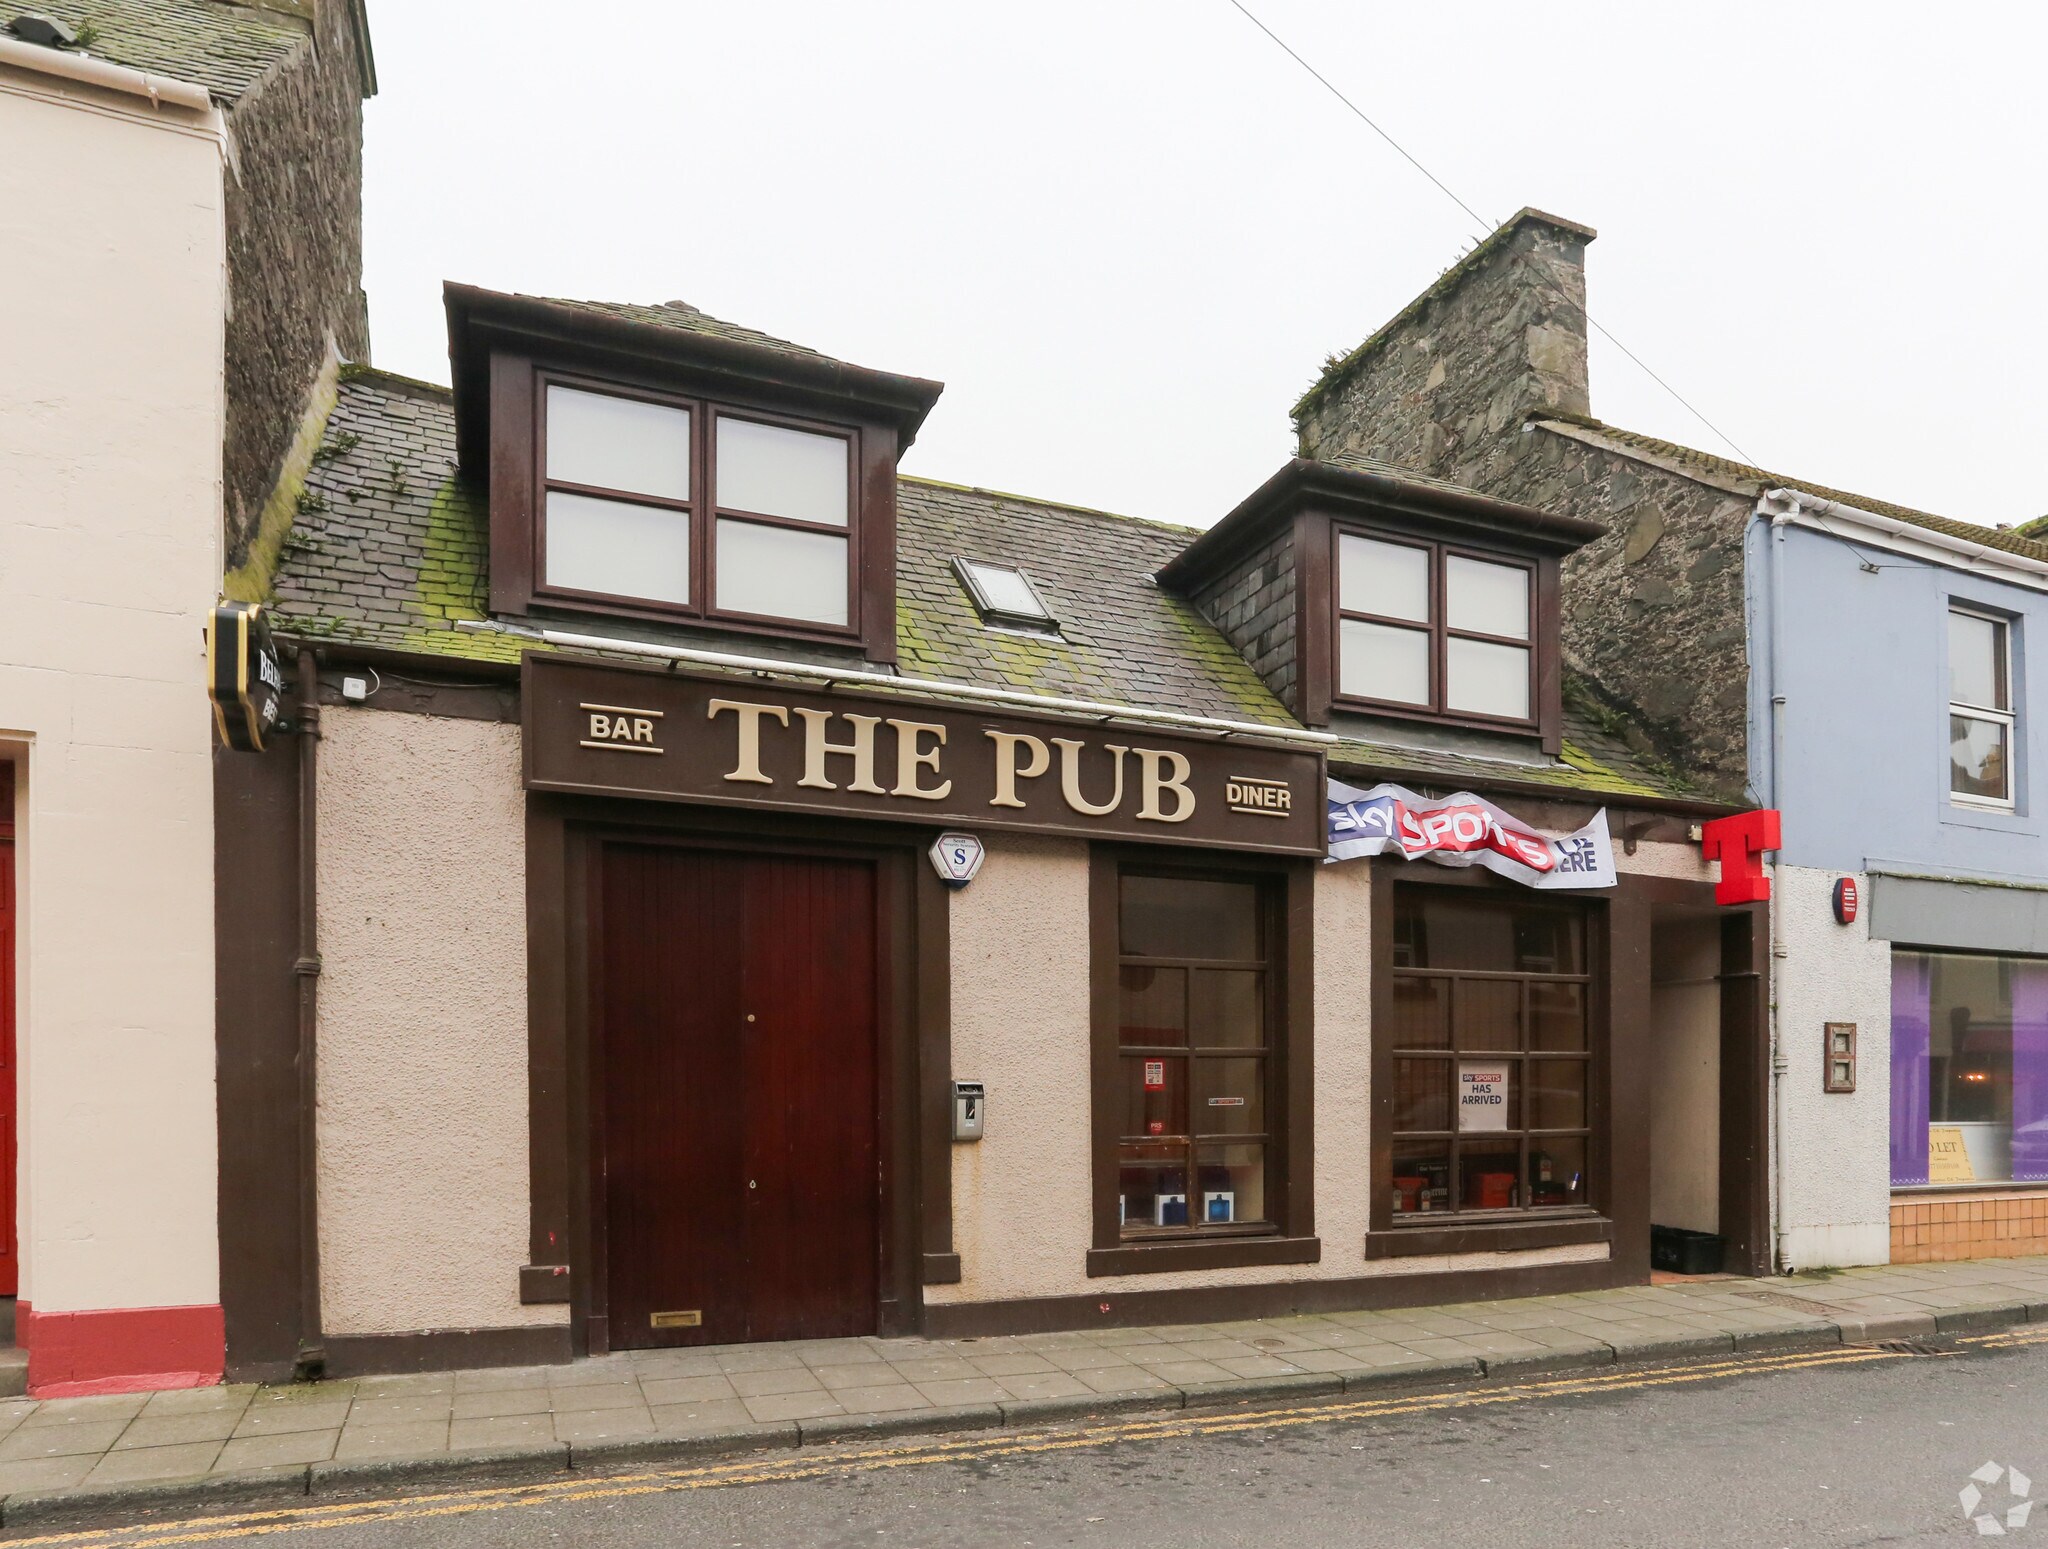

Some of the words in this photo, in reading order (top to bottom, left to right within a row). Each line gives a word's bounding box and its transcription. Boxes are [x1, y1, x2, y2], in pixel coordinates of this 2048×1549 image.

[590, 714, 654, 743] BAR
[707, 698, 952, 800] THE
[984, 730, 1196, 822] PUB
[1226, 783, 1292, 809] DINER
[1328, 804, 1393, 836] sky
[954, 848, 966, 865] S
[1474, 1074, 1500, 1082] SPORTS
[1472, 1084, 1492, 1093] HAS
[1461, 1095, 1502, 1105] ARRIVED
[1936, 1141, 1957, 1153] LET
